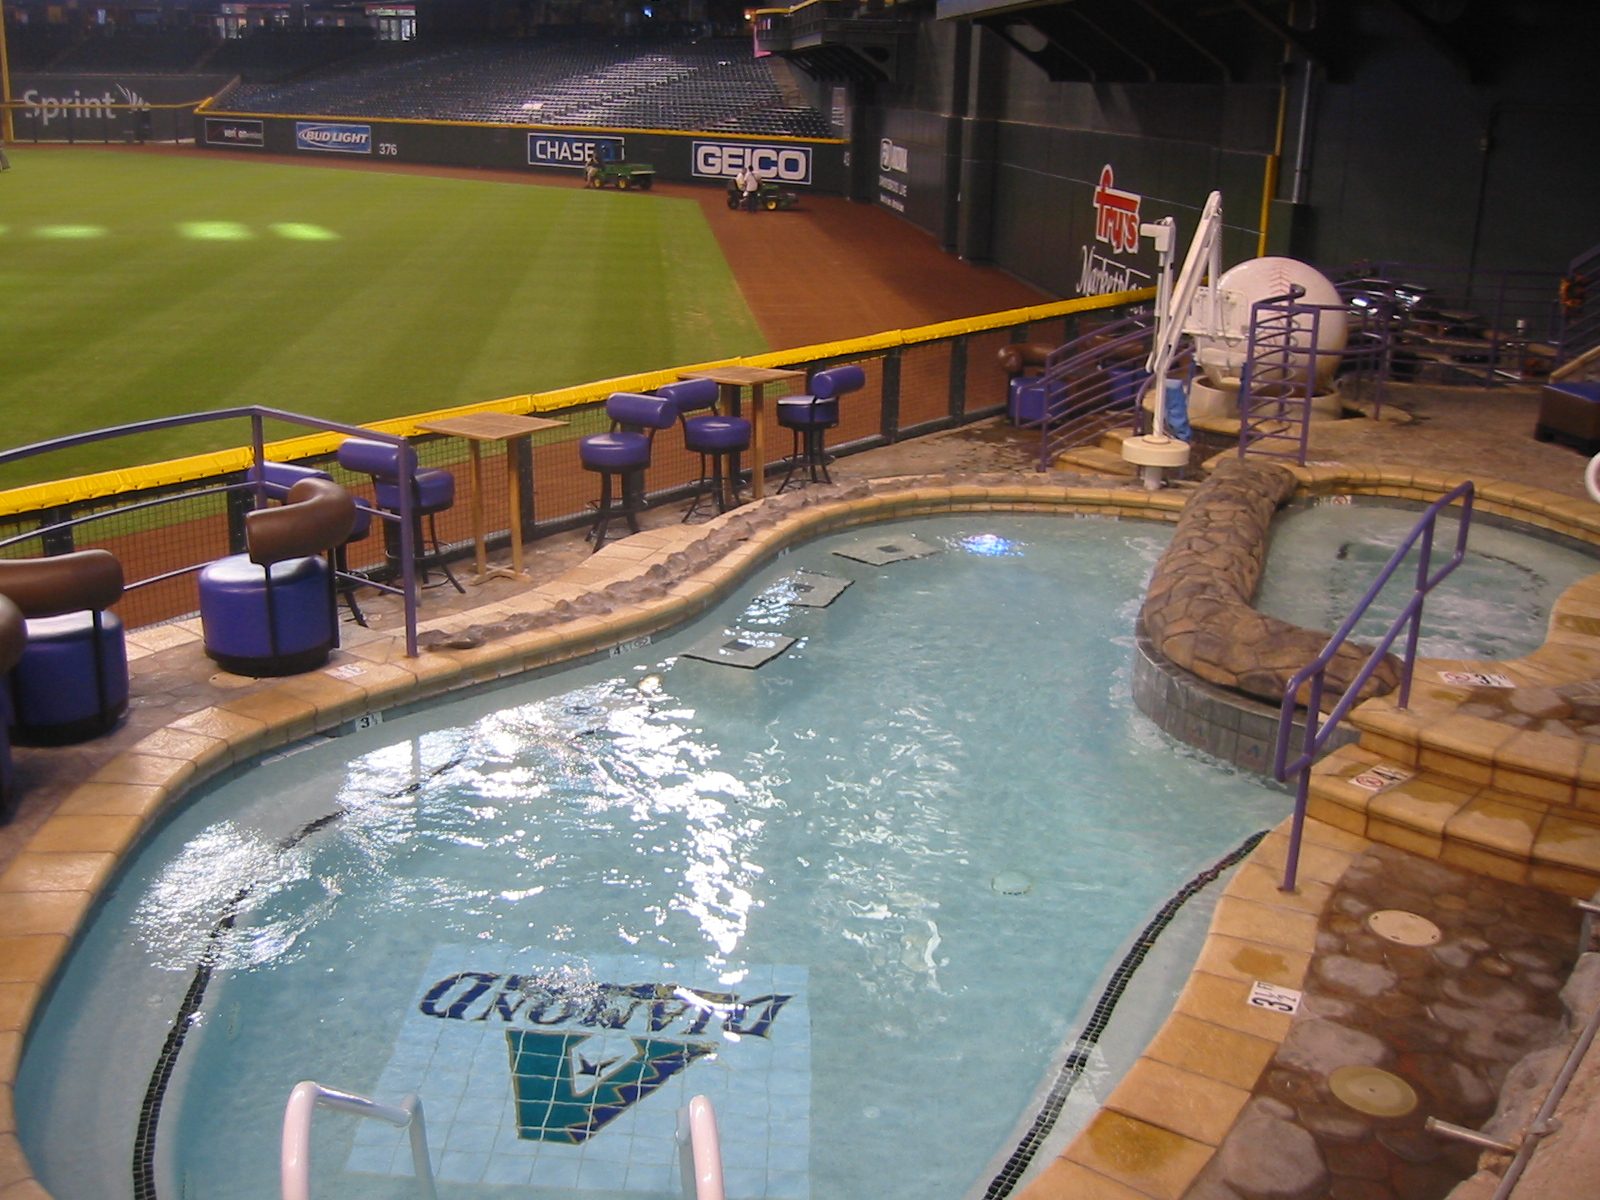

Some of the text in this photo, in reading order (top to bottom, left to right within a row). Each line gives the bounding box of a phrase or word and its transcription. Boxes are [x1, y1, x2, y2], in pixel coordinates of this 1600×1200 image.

[23, 89, 117, 126] Sprint
[306, 130, 369, 144] BUD LIGHT
[378, 143, 398, 155] 376
[535, 139, 596, 162] CHASE
[696, 145, 807, 180] GEICO
[418, 971, 798, 1040] DIAMOND
